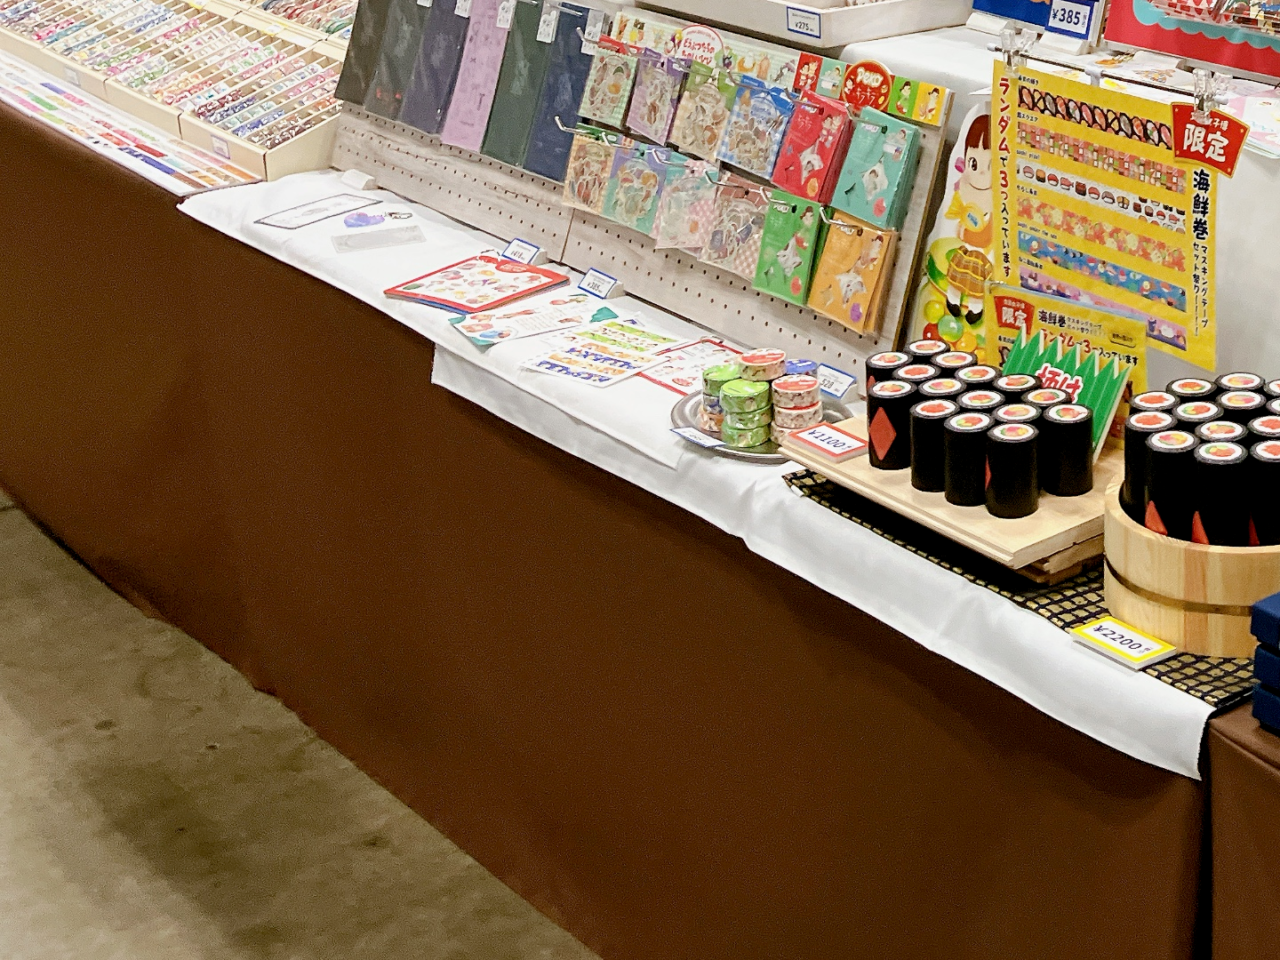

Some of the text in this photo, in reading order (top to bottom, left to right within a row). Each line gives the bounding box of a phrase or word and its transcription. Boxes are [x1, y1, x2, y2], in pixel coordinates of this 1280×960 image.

[1052, 8, 1081, 25] ¥385
[1183, 124, 1229, 163] 限定
[1192, 169, 1211, 241] 海鮮巻
[1002, 306, 1027, 327] 限定
[808, 428, 847, 450] ¥1100
[1093, 624, 1142, 650] ¥2200
